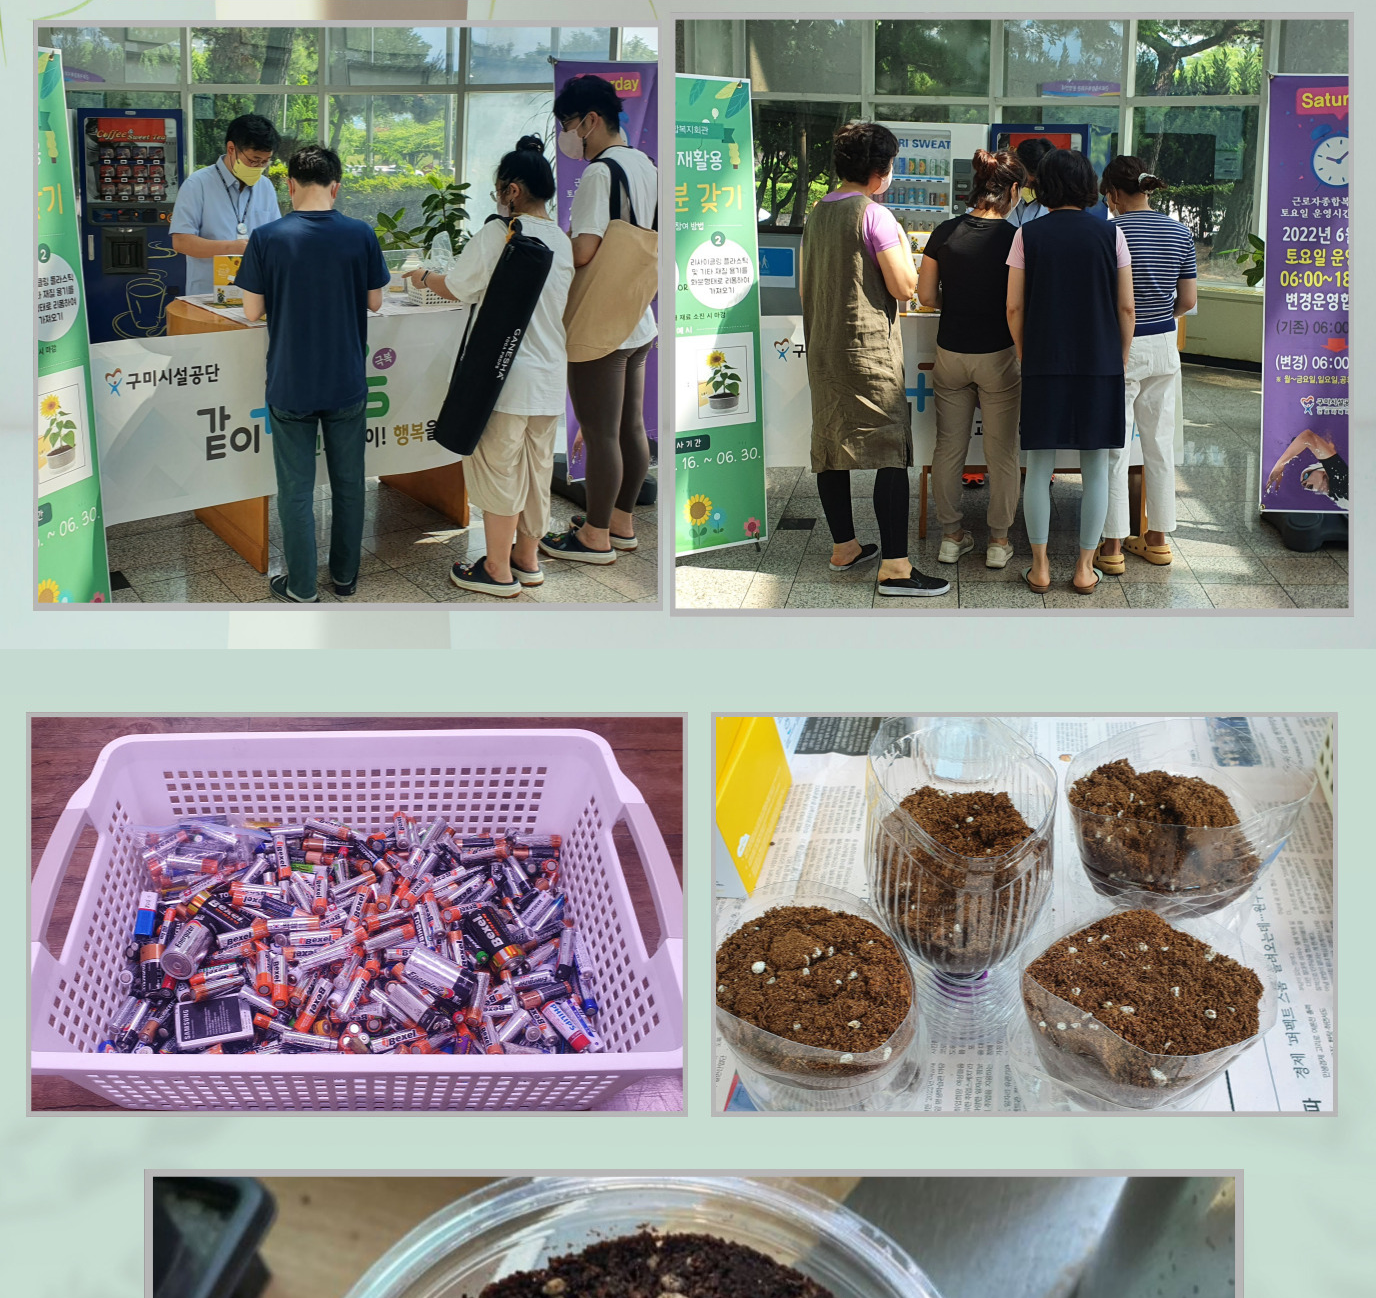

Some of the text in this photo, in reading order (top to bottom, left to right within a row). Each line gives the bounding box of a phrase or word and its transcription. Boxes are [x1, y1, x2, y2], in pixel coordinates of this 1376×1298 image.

[97, 130, 127, 140] Coffee
[912, 139, 951, 150] SWEAT
[677, 149, 722, 171] 재활용
[697, 183, 742, 213] 갖기
[1281, 208, 1308, 218] 토요일
[1282, 227, 1331, 244] 2022년
[1285, 249, 1326, 267] 토요일
[1276, 320, 1309, 335] (기존)
[496, 329, 521, 380] GANESHA
[1275, 354, 1308, 371] (변경)
[126, 363, 220, 390] 구미시설공단
[197, 406, 260, 460] 같이
[682, 447, 761, 470] 16. 06. 30.
[60, 507, 100, 536] 06. 30.
[277, 846, 286, 867] Bexel
[208, 900, 243, 923] Bexel
[354, 893, 365, 918] Bexel
[176, 925, 195, 948] Energizer
[227, 932, 252, 943] Bexel
[306, 935, 332, 944] Bexel
[472, 914, 504, 948] Bexel
[273, 961, 281, 983] Bexel
[310, 987, 325, 1015] Bexel
[550, 1004, 576, 1031] PHILIPS
[388, 1030, 416, 1046] Bexel
[1290, 1053, 1310, 1079] 경제
